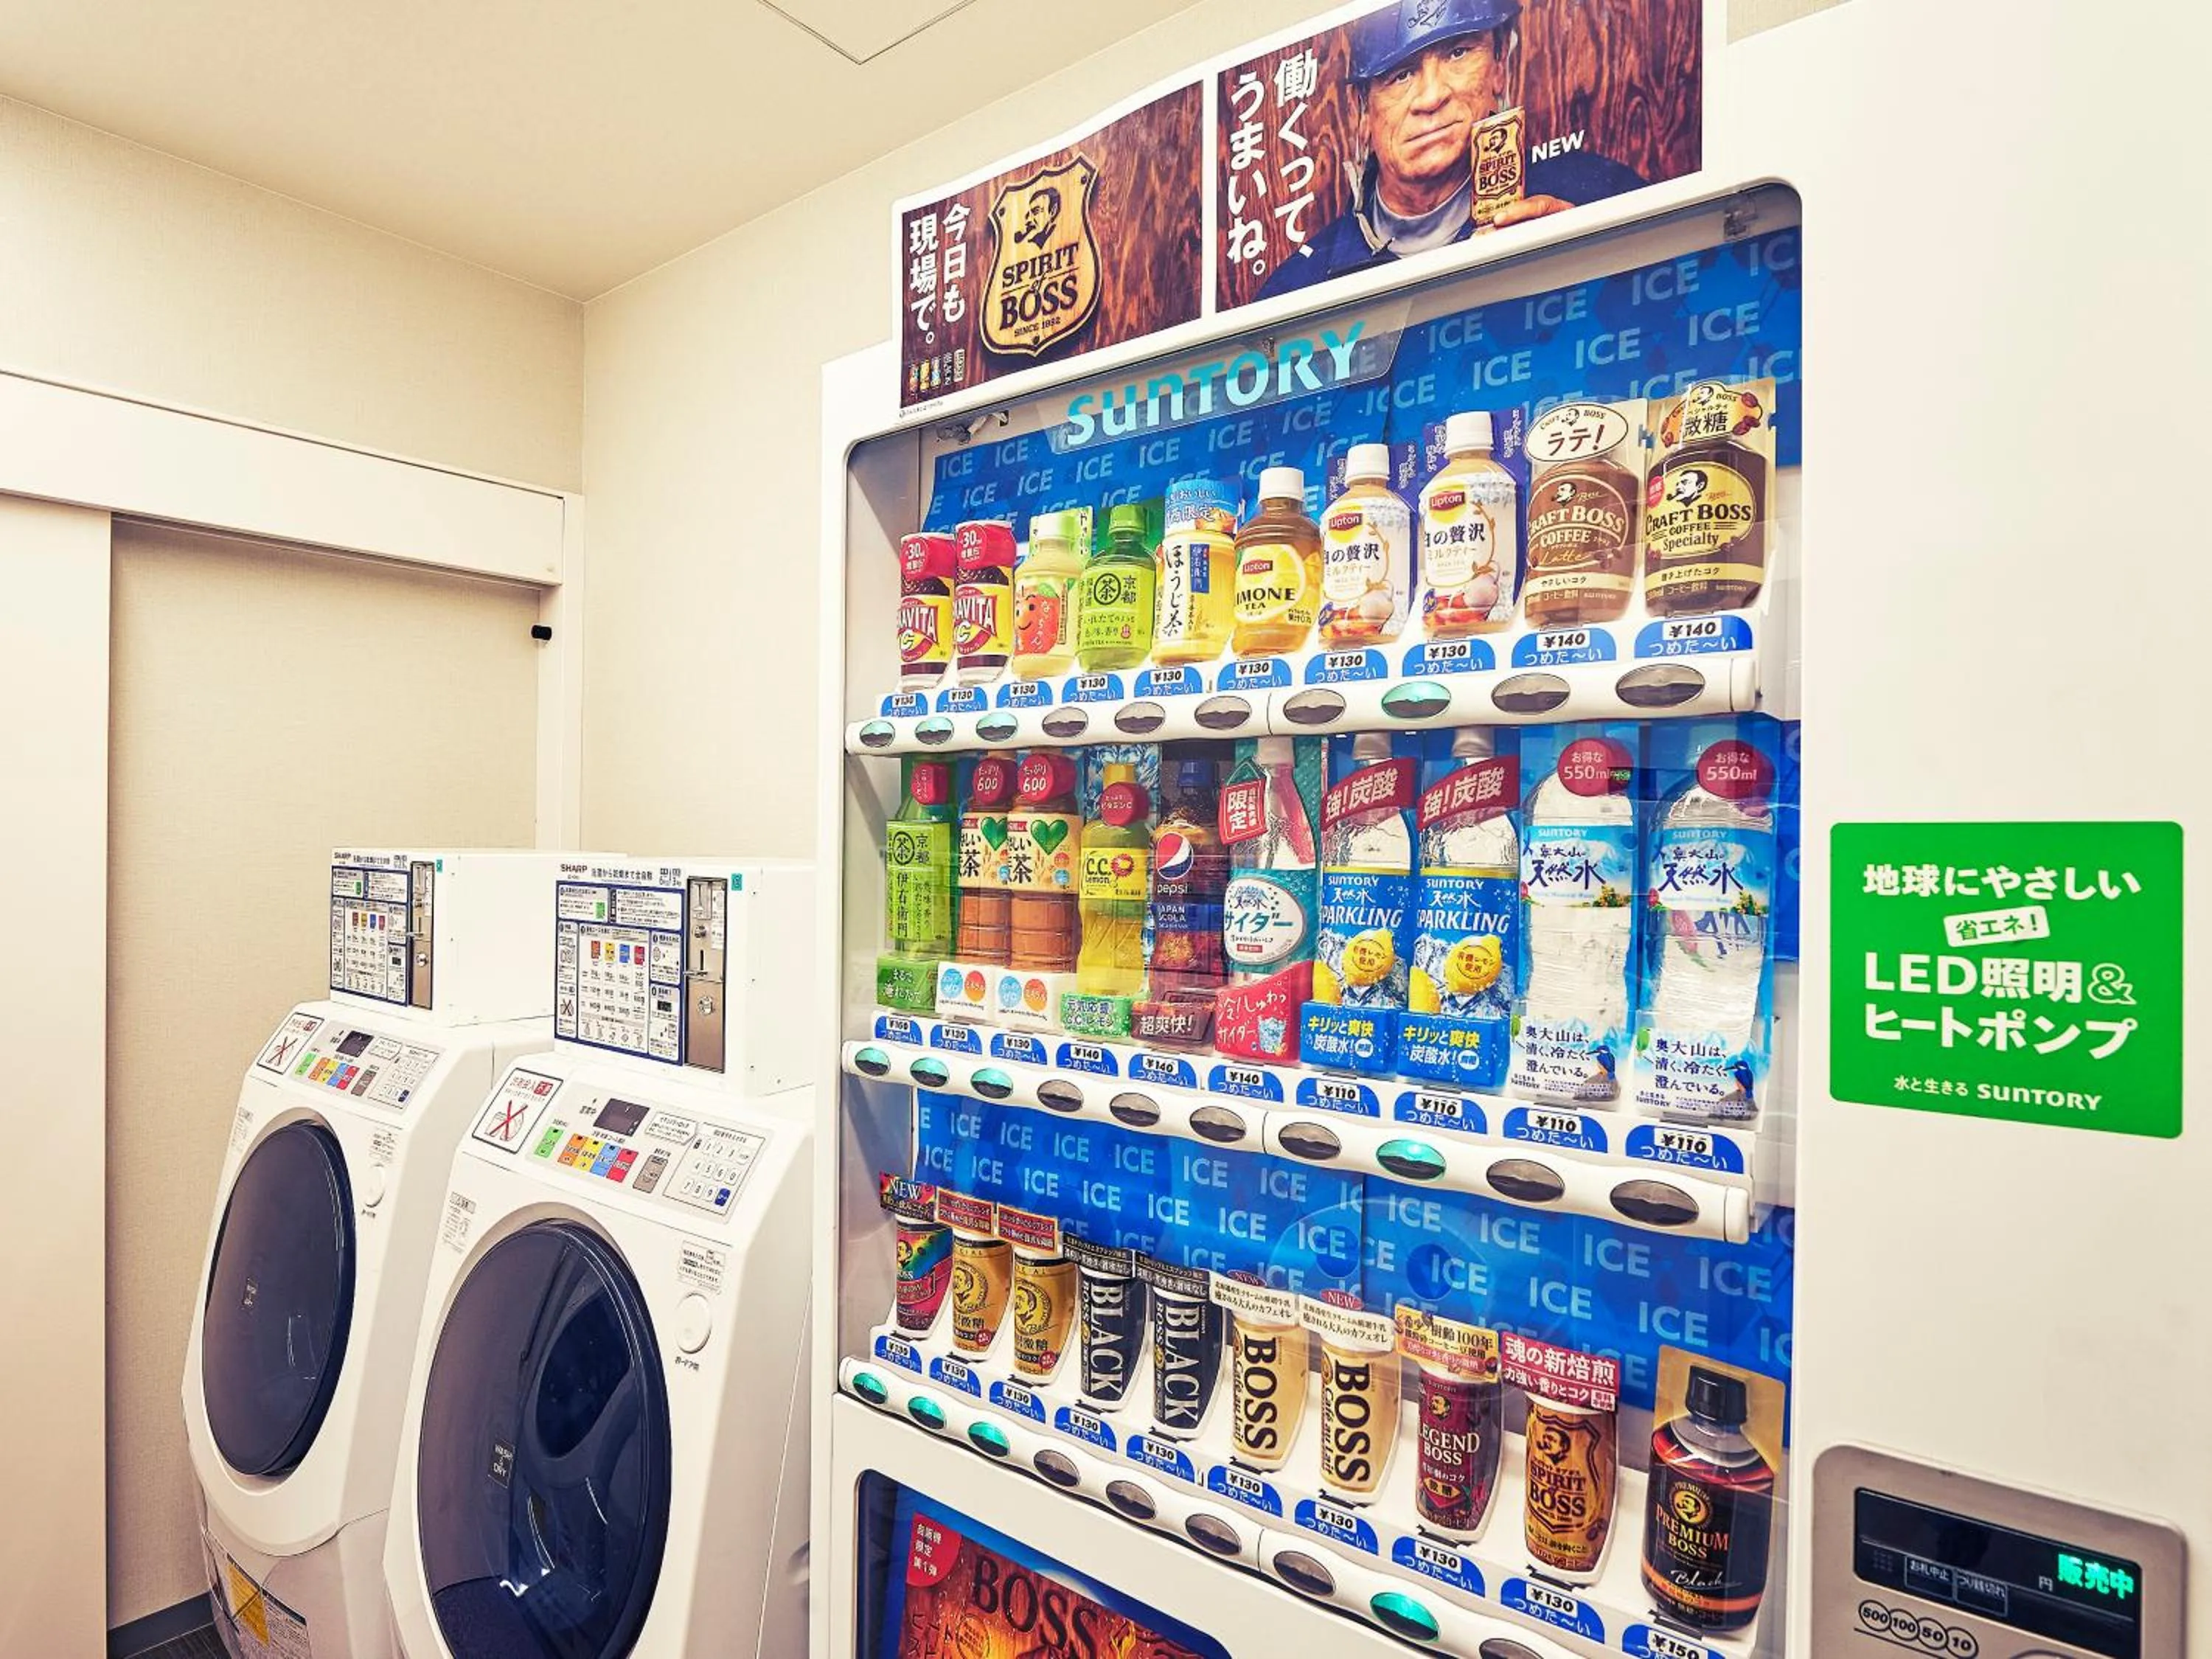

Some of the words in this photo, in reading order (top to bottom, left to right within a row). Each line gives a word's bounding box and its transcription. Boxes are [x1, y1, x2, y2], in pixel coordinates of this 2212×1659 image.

[1273, 49, 1318, 258] 働くって、
[1531, 130, 1585, 164] NEW
[1228, 74, 1267, 276] うまいね。
[1479, 153, 1517, 175] SPIRIT
[1478, 167, 1517, 192] BOSS
[942, 204, 971, 323] 今日も
[1002, 243, 1079, 288] SPIRIT
[910, 213, 939, 344] 現場で。
[1631, 257, 1700, 306] ICE
[999, 274, 1078, 330] BOSS
[1523, 288, 1587, 330] ICE
[1014, 322, 1039, 338] SINCE
[1688, 302, 1760, 346] ICE
[1574, 327, 1641, 369] ICE
[1716, 393, 1737, 402] BOSS
[1282, 401, 1332, 434] ICE
[1207, 420, 1253, 452] ICE
[1548, 424, 1605, 456] ラテ!
[995, 439, 1029, 467] ICE
[941, 453, 973, 479] ICE
[1076, 453, 1114, 484] ICE
[1017, 468, 1054, 496] ICE
[1430, 493, 1463, 510] Lipton
[1330, 515, 1360, 528] Lipton
[1572, 505, 1625, 532] BOSS
[1645, 507, 1694, 536] CRAFT
[1697, 504, 1751, 521] BOSS
[1669, 522, 1711, 536] COFFEE
[963, 531, 977, 547] 30
[1540, 529, 1591, 548] COFFEE
[1663, 532, 1719, 553] Specialty
[1121, 575, 1137, 604] 京都
[1545, 633, 1585, 647] ¥140
[1669, 622, 1716, 638] ¥140
[1329, 655, 1363, 667] ¥130
[1428, 645, 1467, 658] ¥130
[1154, 671, 1182, 682] ¥130
[1238, 663, 1269, 674] ¥130
[1012, 684, 1035, 695] ¥130
[1079, 678, 1105, 689] ¥130
[1571, 751, 1604, 762] お得な
[1714, 752, 1749, 762] お得な
[978, 779, 998, 790] 600
[1564, 766, 1611, 779] 550ml
[1707, 767, 1757, 781] 550ml
[1023, 778, 1046, 792] 600
[1325, 768, 1399, 823] 強!炭酸
[1422, 767, 1505, 823] 強!炭酸
[1227, 790, 1248, 832] 限定
[1539, 829, 1587, 838] SUNTORY
[1672, 830, 1726, 839] SUNTORY
[916, 833, 929, 863] 京都
[560, 864, 588, 873] SHARP
[1086, 858, 1112, 875] C.C.
[1528, 860, 1606, 889] 天然水
[1658, 863, 1743, 894] 天然水
[1157, 884, 1187, 895] pepsi
[1328, 876, 1380, 886] SUNTORY
[1427, 878, 1484, 890] SUNTORY
[1863, 863, 2141, 900] 地球にやさしい
[1158, 905, 1186, 913] JAPAN
[1332, 887, 1377, 907] 天然水
[1430, 891, 1481, 909] 天然水
[1225, 912, 1293, 933] サイダー
[1321, 905, 1403, 928] PARKLING
[1956, 914, 2039, 942] 省エネ!
[1865, 951, 2137, 1005] LED照明&
[1140, 1015, 1192, 1034] 超爽快!
[1217, 1017, 1256, 1044] サイダー
[1308, 1016, 1374, 1037] キリッと爽快
[1526, 1025, 1589, 1043] 奥大山は、
[1865, 1003, 2138, 1060] ヒートポンプ
[1006, 1038, 1029, 1049] ¥130
[1313, 1035, 1354, 1053] 炭酸水!
[1403, 1026, 1481, 1048] キリッと爽快
[1656, 1037, 1726, 1058] 奥大山は、
[1074, 1047, 1099, 1060] ¥140
[1410, 1046, 1456, 1066] 炭酸水!
[1526, 1043, 1590, 1061] 清く、冷たく、
[1146, 1057, 1174, 1073] ¥140
[1526, 1060, 1588, 1078] 澄んでいる。
[1655, 1057, 1727, 1077] 清く、冷たく、
[1230, 1071, 1259, 1085] ¥140
[1655, 1076, 1725, 1096] 澄んでいる。
[1324, 1085, 1356, 1099] ¥110
[1893, 1075, 1968, 1096] 水と生きる
[1977, 1083, 2103, 1110] SUNTORY
[1422, 1099, 1456, 1116] ¥110
[1000, 1121, 1032, 1150] ICE
[1536, 1116, 1576, 1132] ¥110
[1054, 1132, 1089, 1162] ICE
[1661, 1134, 1707, 1153] ¥110
[924, 1144, 955, 1172] ICE
[970, 1155, 1004, 1185] ICE
[889, 1178, 919, 1200] NEW
[1082, 1180, 1121, 1211] ICE
[1259, 1167, 1308, 1203] ICE
[1147, 1192, 1190, 1227] ICE
[1388, 1194, 1441, 1233] ICE
[1218, 1207, 1267, 1242] ICE
[1298, 1222, 1347, 1259] ICE
[1585, 1233, 1652, 1279] ICE
[1699, 1256, 1773, 1304] ICE
[1327, 1292, 1355, 1308] NEW
[1156, 1303, 1164, 1346] BOSS
[1638, 1300, 1708, 1347] ICE
[1091, 1284, 1124, 1394] BLACK
[1164, 1306, 1199, 1422] BLACK
[1505, 1336, 1615, 1386] 魂の新焙煎
[1245, 1334, 1277, 1449] BOSS
[1504, 1366, 1589, 1402] 力強い香りとコク
[1073, 1416, 1098, 1432] ¥130
[1335, 1359, 1370, 1481] BOSS
[1146, 1441, 1174, 1460] ¥130
[1424, 1441, 1462, 1465] BOSS
[493, 1463, 507, 1478] DRY
[1229, 1472, 1259, 1493] ¥130
[1530, 1466, 1585, 1492] SPIRIT
[1529, 1480, 1585, 1518] BOSS
[1319, 1508, 1353, 1528] ¥130
[1655, 1504, 1728, 1551] PREMIUM
[1420, 1546, 1458, 1568] ¥130
[1669, 1533, 1707, 1559] BOSS
[2038, 1576, 2054, 1593] 円
[2057, 1553, 2135, 1600] 販売中
[973, 1556, 1098, 1658] BOSS
[1531, 1589, 1573, 1613] ¥130
[1863, 1607, 1889, 1624] 500
[1892, 1616, 1916, 1635] 100
[1922, 1627, 1943, 1642] 50
[1952, 1636, 1972, 1652] 10
[1653, 1633, 1700, 1659] ¥150
